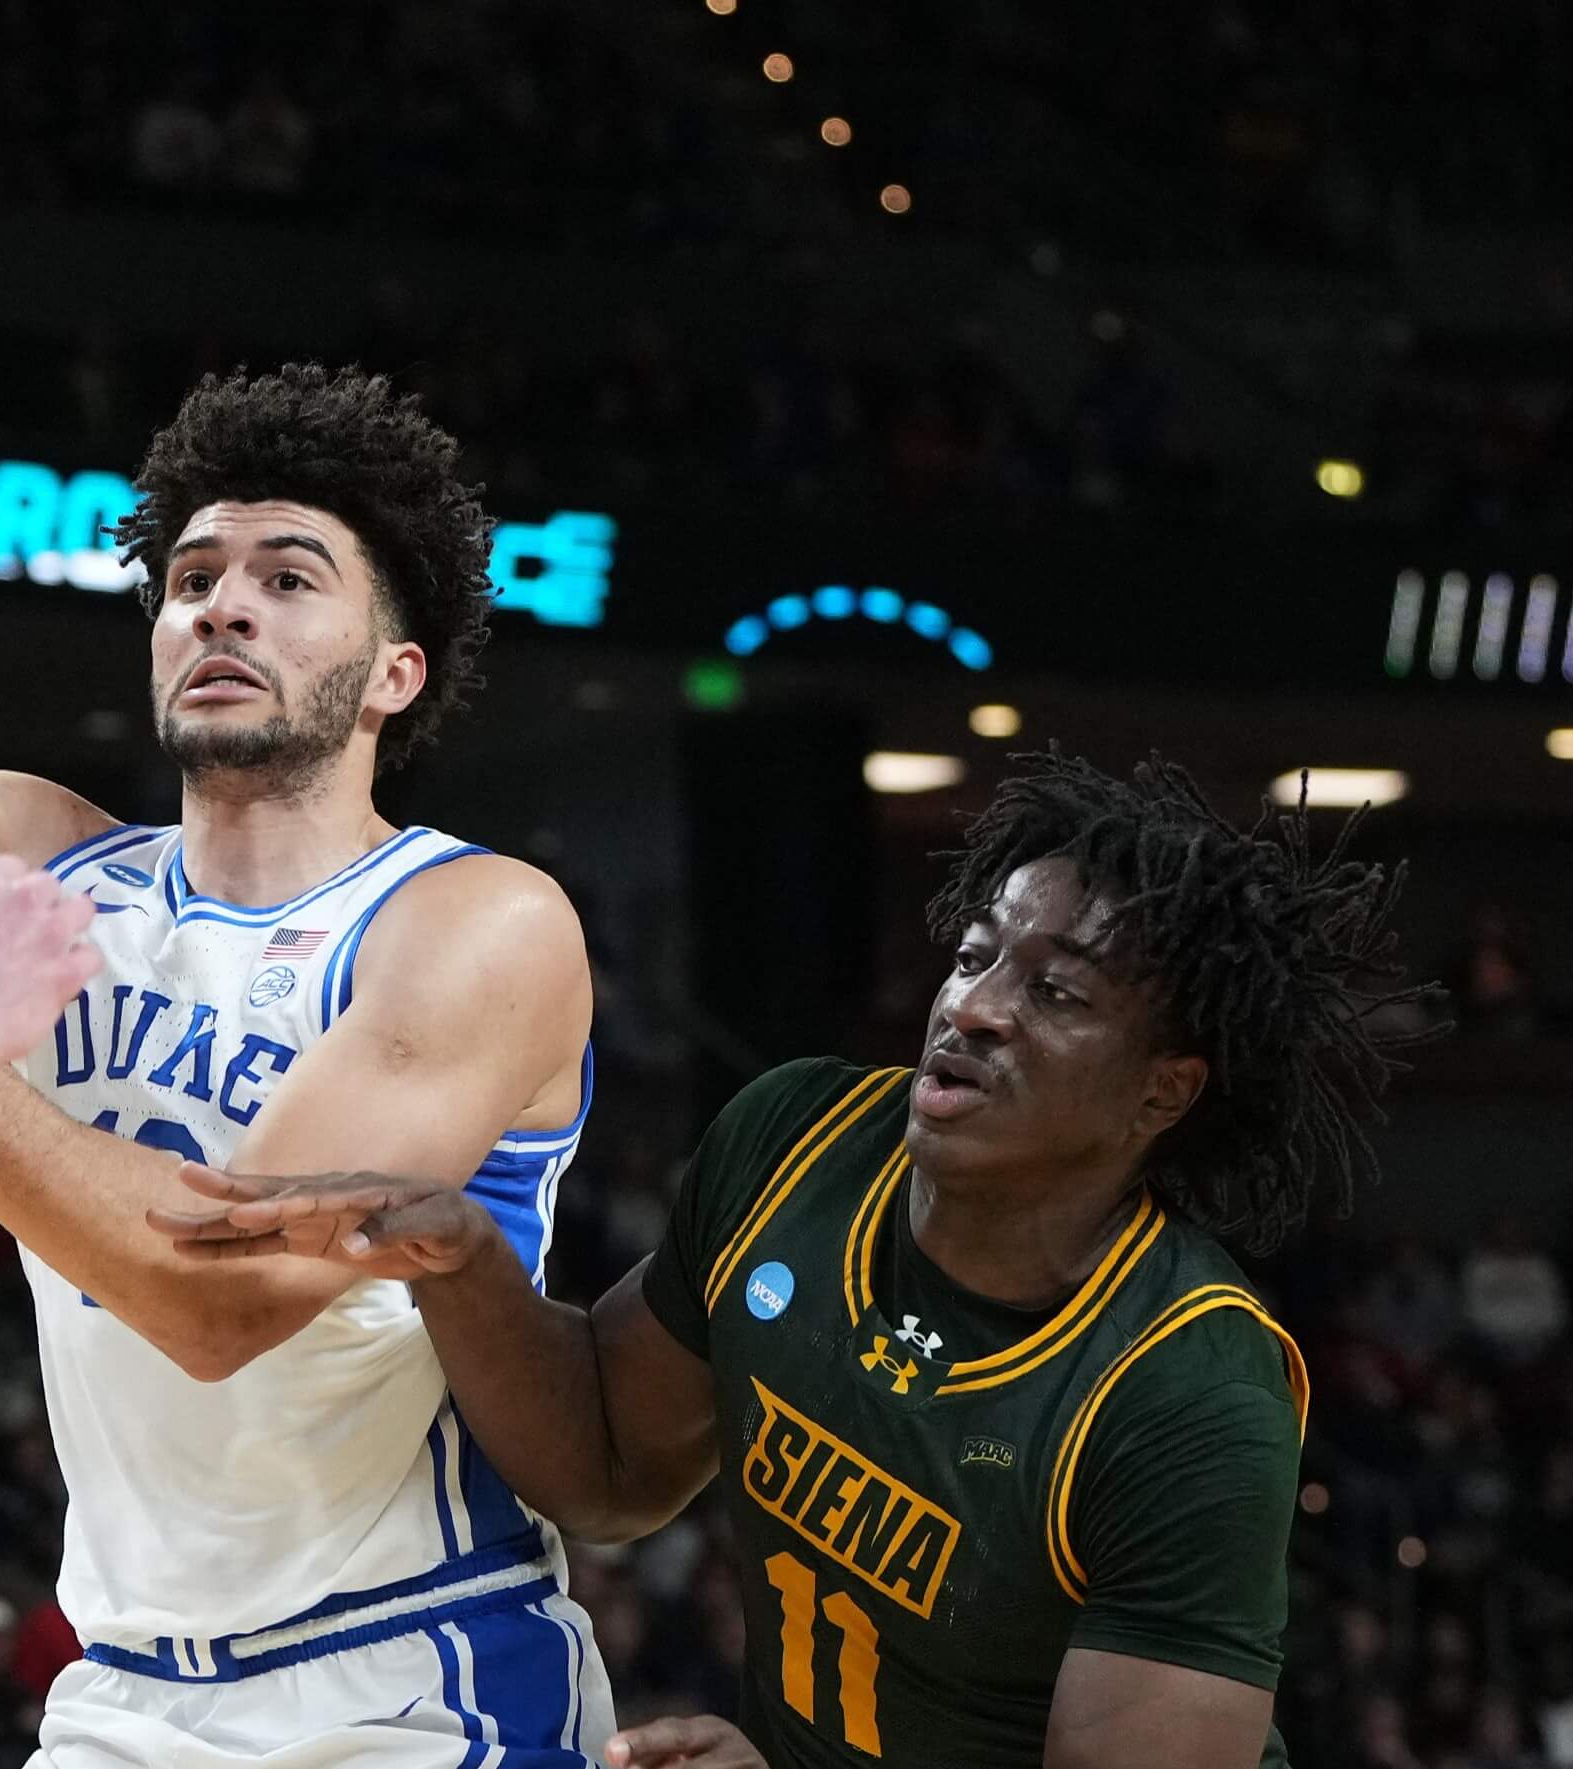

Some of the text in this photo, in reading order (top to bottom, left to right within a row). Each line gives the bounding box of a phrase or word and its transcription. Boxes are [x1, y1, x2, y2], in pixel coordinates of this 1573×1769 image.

[54, 985, 298, 1128] DUKE
[749, 1279, 784, 1313] NCAA
[749, 1414, 949, 1606] SIENA
[959, 1439, 1014, 1467] MAAC
[764, 1550, 882, 1758] 11
